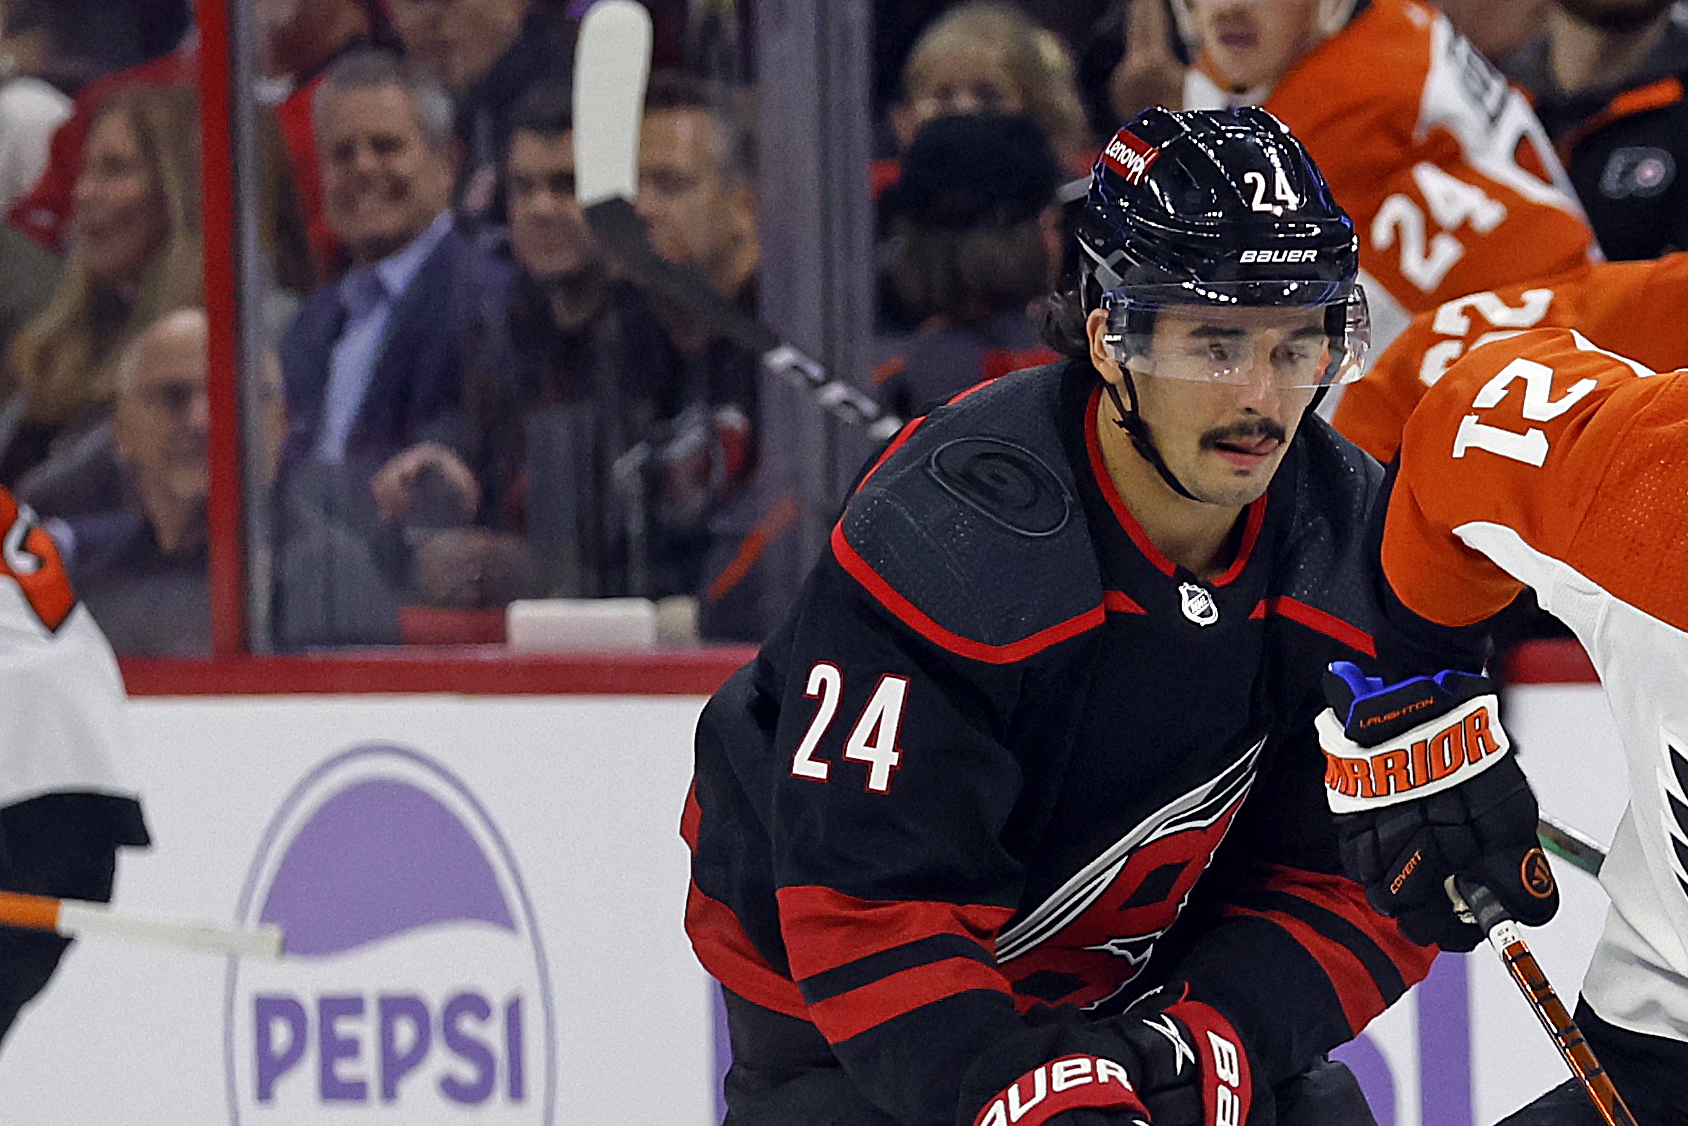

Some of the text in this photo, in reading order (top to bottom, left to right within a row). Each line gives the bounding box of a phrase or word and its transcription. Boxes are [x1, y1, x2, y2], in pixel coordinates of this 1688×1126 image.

[1242, 171, 1301, 213] 24
[1371, 161, 1508, 293] 24
[1239, 249, 1318, 264] BAUER
[1452, 357, 1598, 468] 21
[791, 660, 911, 795] 24
[1321, 706, 1500, 799] ARRIOR
[1359, 697, 1435, 729] LAUGHTON
[1389, 849, 1423, 895] COVERT
[255, 993, 524, 1105] PEPSI
